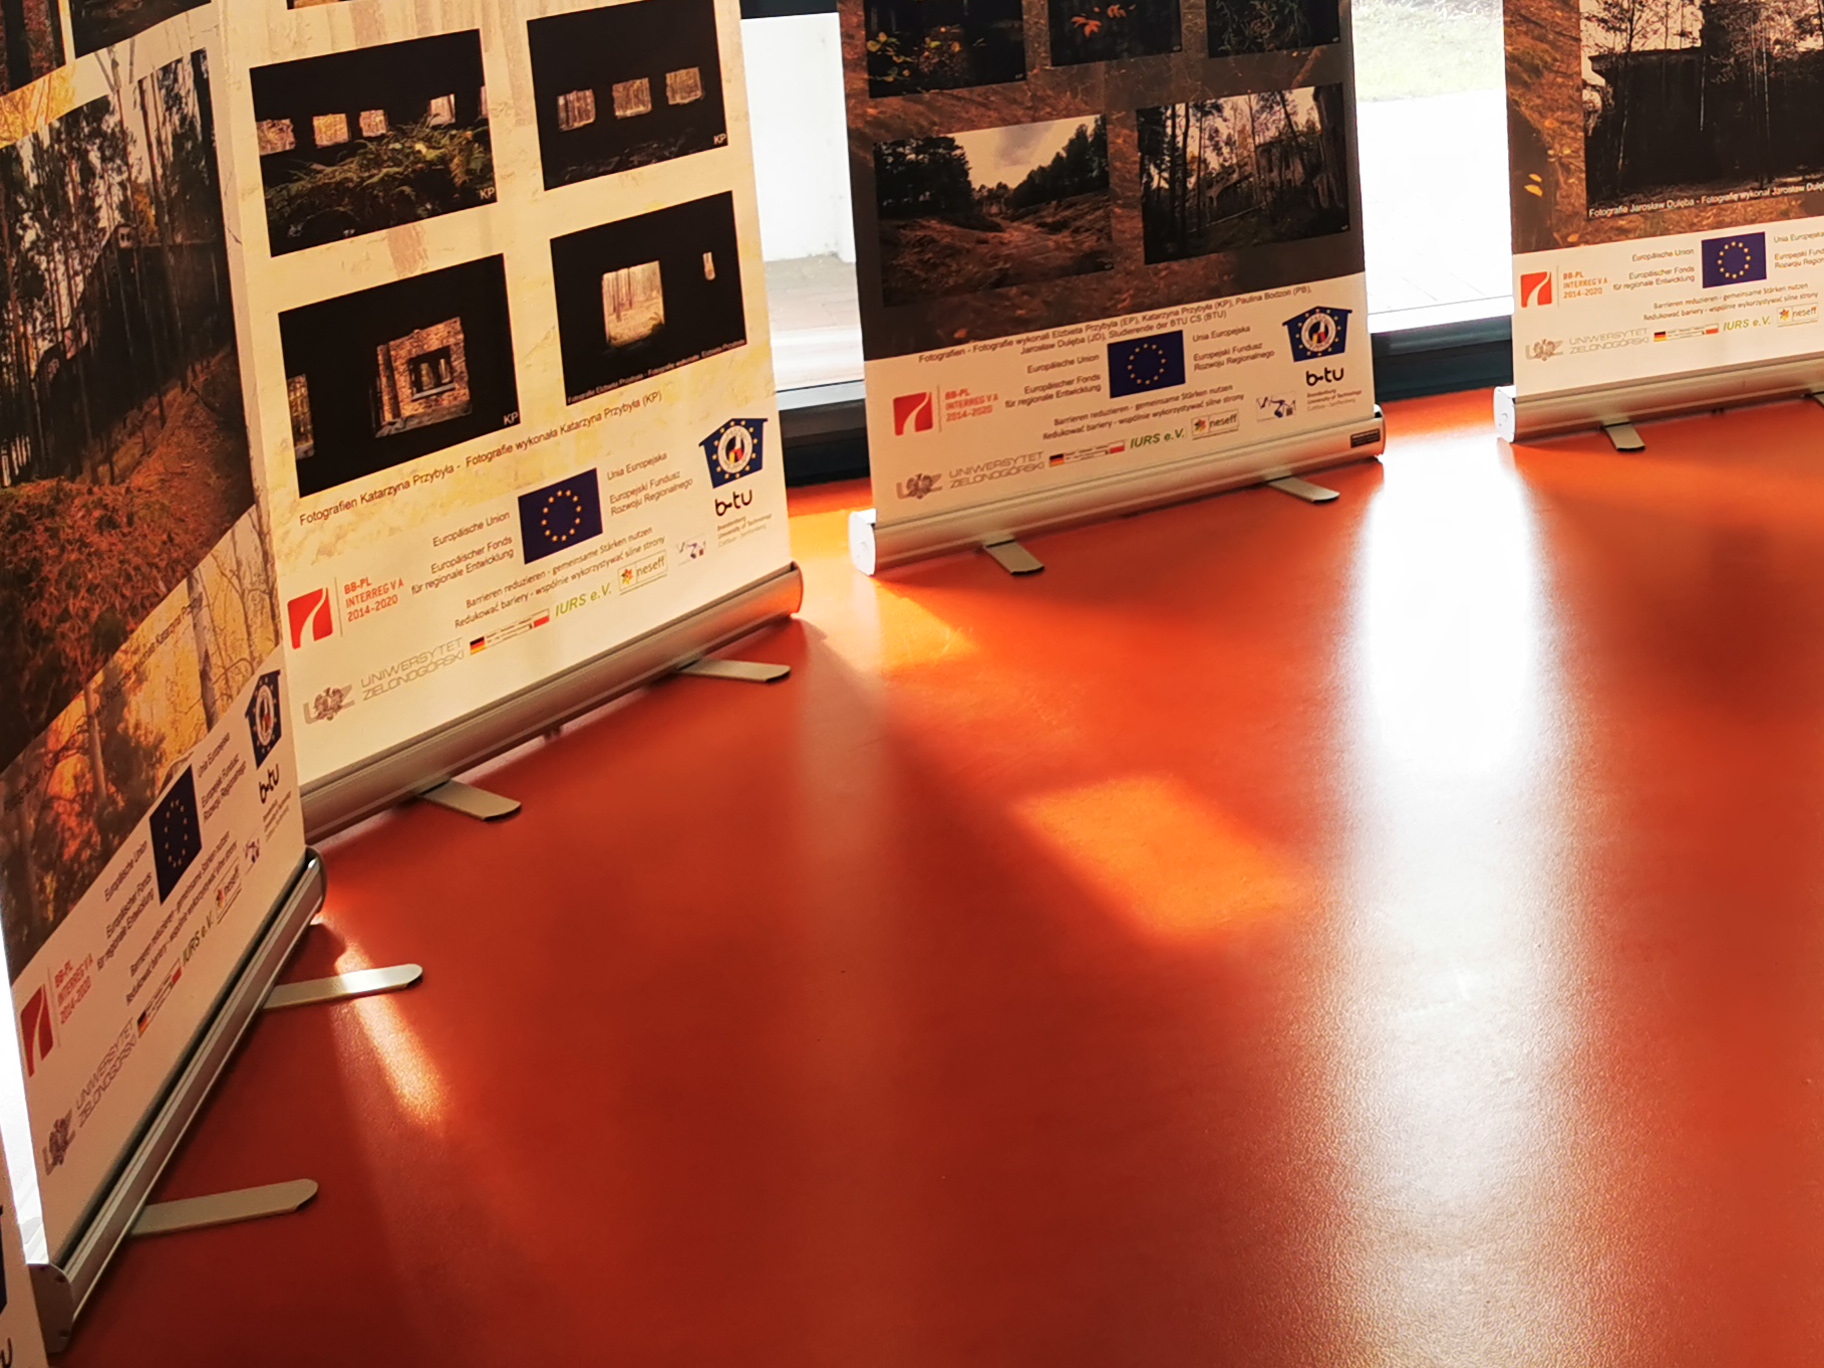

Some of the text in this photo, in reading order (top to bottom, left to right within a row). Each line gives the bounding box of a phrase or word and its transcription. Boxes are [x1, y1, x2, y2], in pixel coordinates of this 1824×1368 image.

[300, 497, 357, 524] Fotografien
[360, 479, 409, 503] Katarzyna
[413, 464, 453, 485] Przybyła
[466, 443, 512, 467] Fotografie
[515, 427, 557, 449] wykonała
[560, 413, 601, 434] Katarzyna
[604, 399, 640, 418] Przybyła
[636, 555, 665, 576] neseff
[344, 576, 371, 594] BB-PL
[346, 577, 403, 607] INTERREG V A
[555, 583, 611, 616] IURS e.V.
[348, 593, 398, 622] 2014-2020
